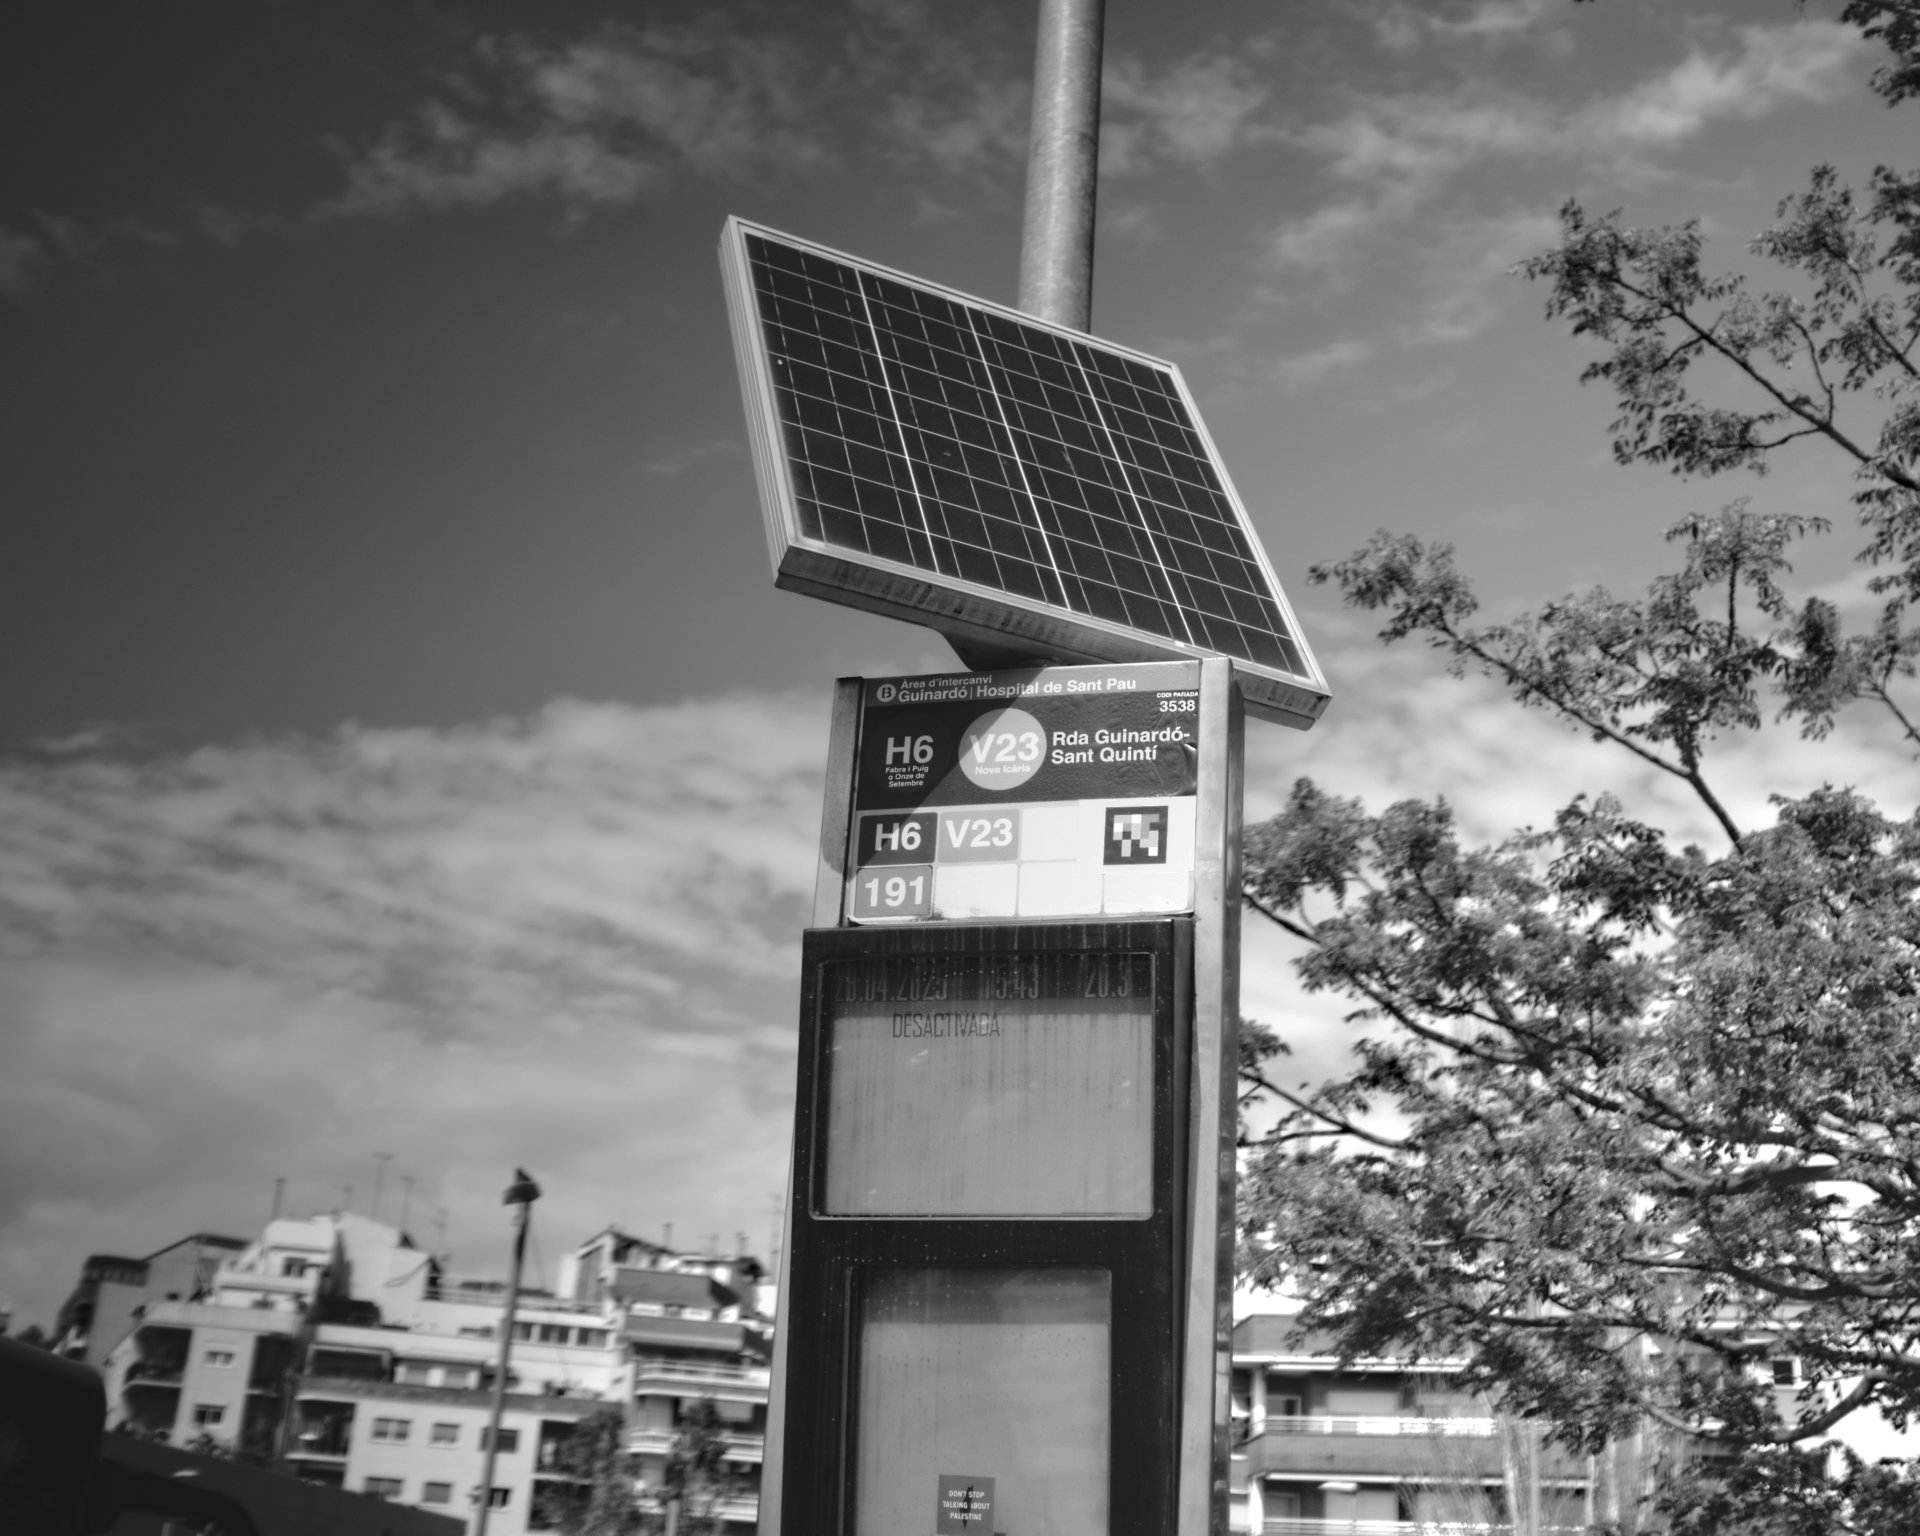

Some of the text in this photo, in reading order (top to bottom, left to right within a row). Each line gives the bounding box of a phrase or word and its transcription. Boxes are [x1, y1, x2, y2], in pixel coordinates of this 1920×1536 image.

[898, 678, 1136, 702] Guinardó Hospital de Sant Pau
[1159, 700, 1196, 712] 3538
[1052, 726, 1191, 746] Rda Guinardó-
[885, 735, 934, 765] H6
[969, 732, 1039, 763] V23
[1051, 745, 1158, 765] Sant Quintí
[885, 766, 907, 774] Fabra
[912, 765, 929, 773] Puig
[975, 766, 1000, 775] Nova
[888, 780, 924, 788] Setembre
[874, 822, 921, 851] H6
[945, 818, 1014, 848] V23
[864, 875, 925, 907] 191
[942, 1501, 968, 1509] TALKING
[950, 1512, 982, 1520] PALESTINE
